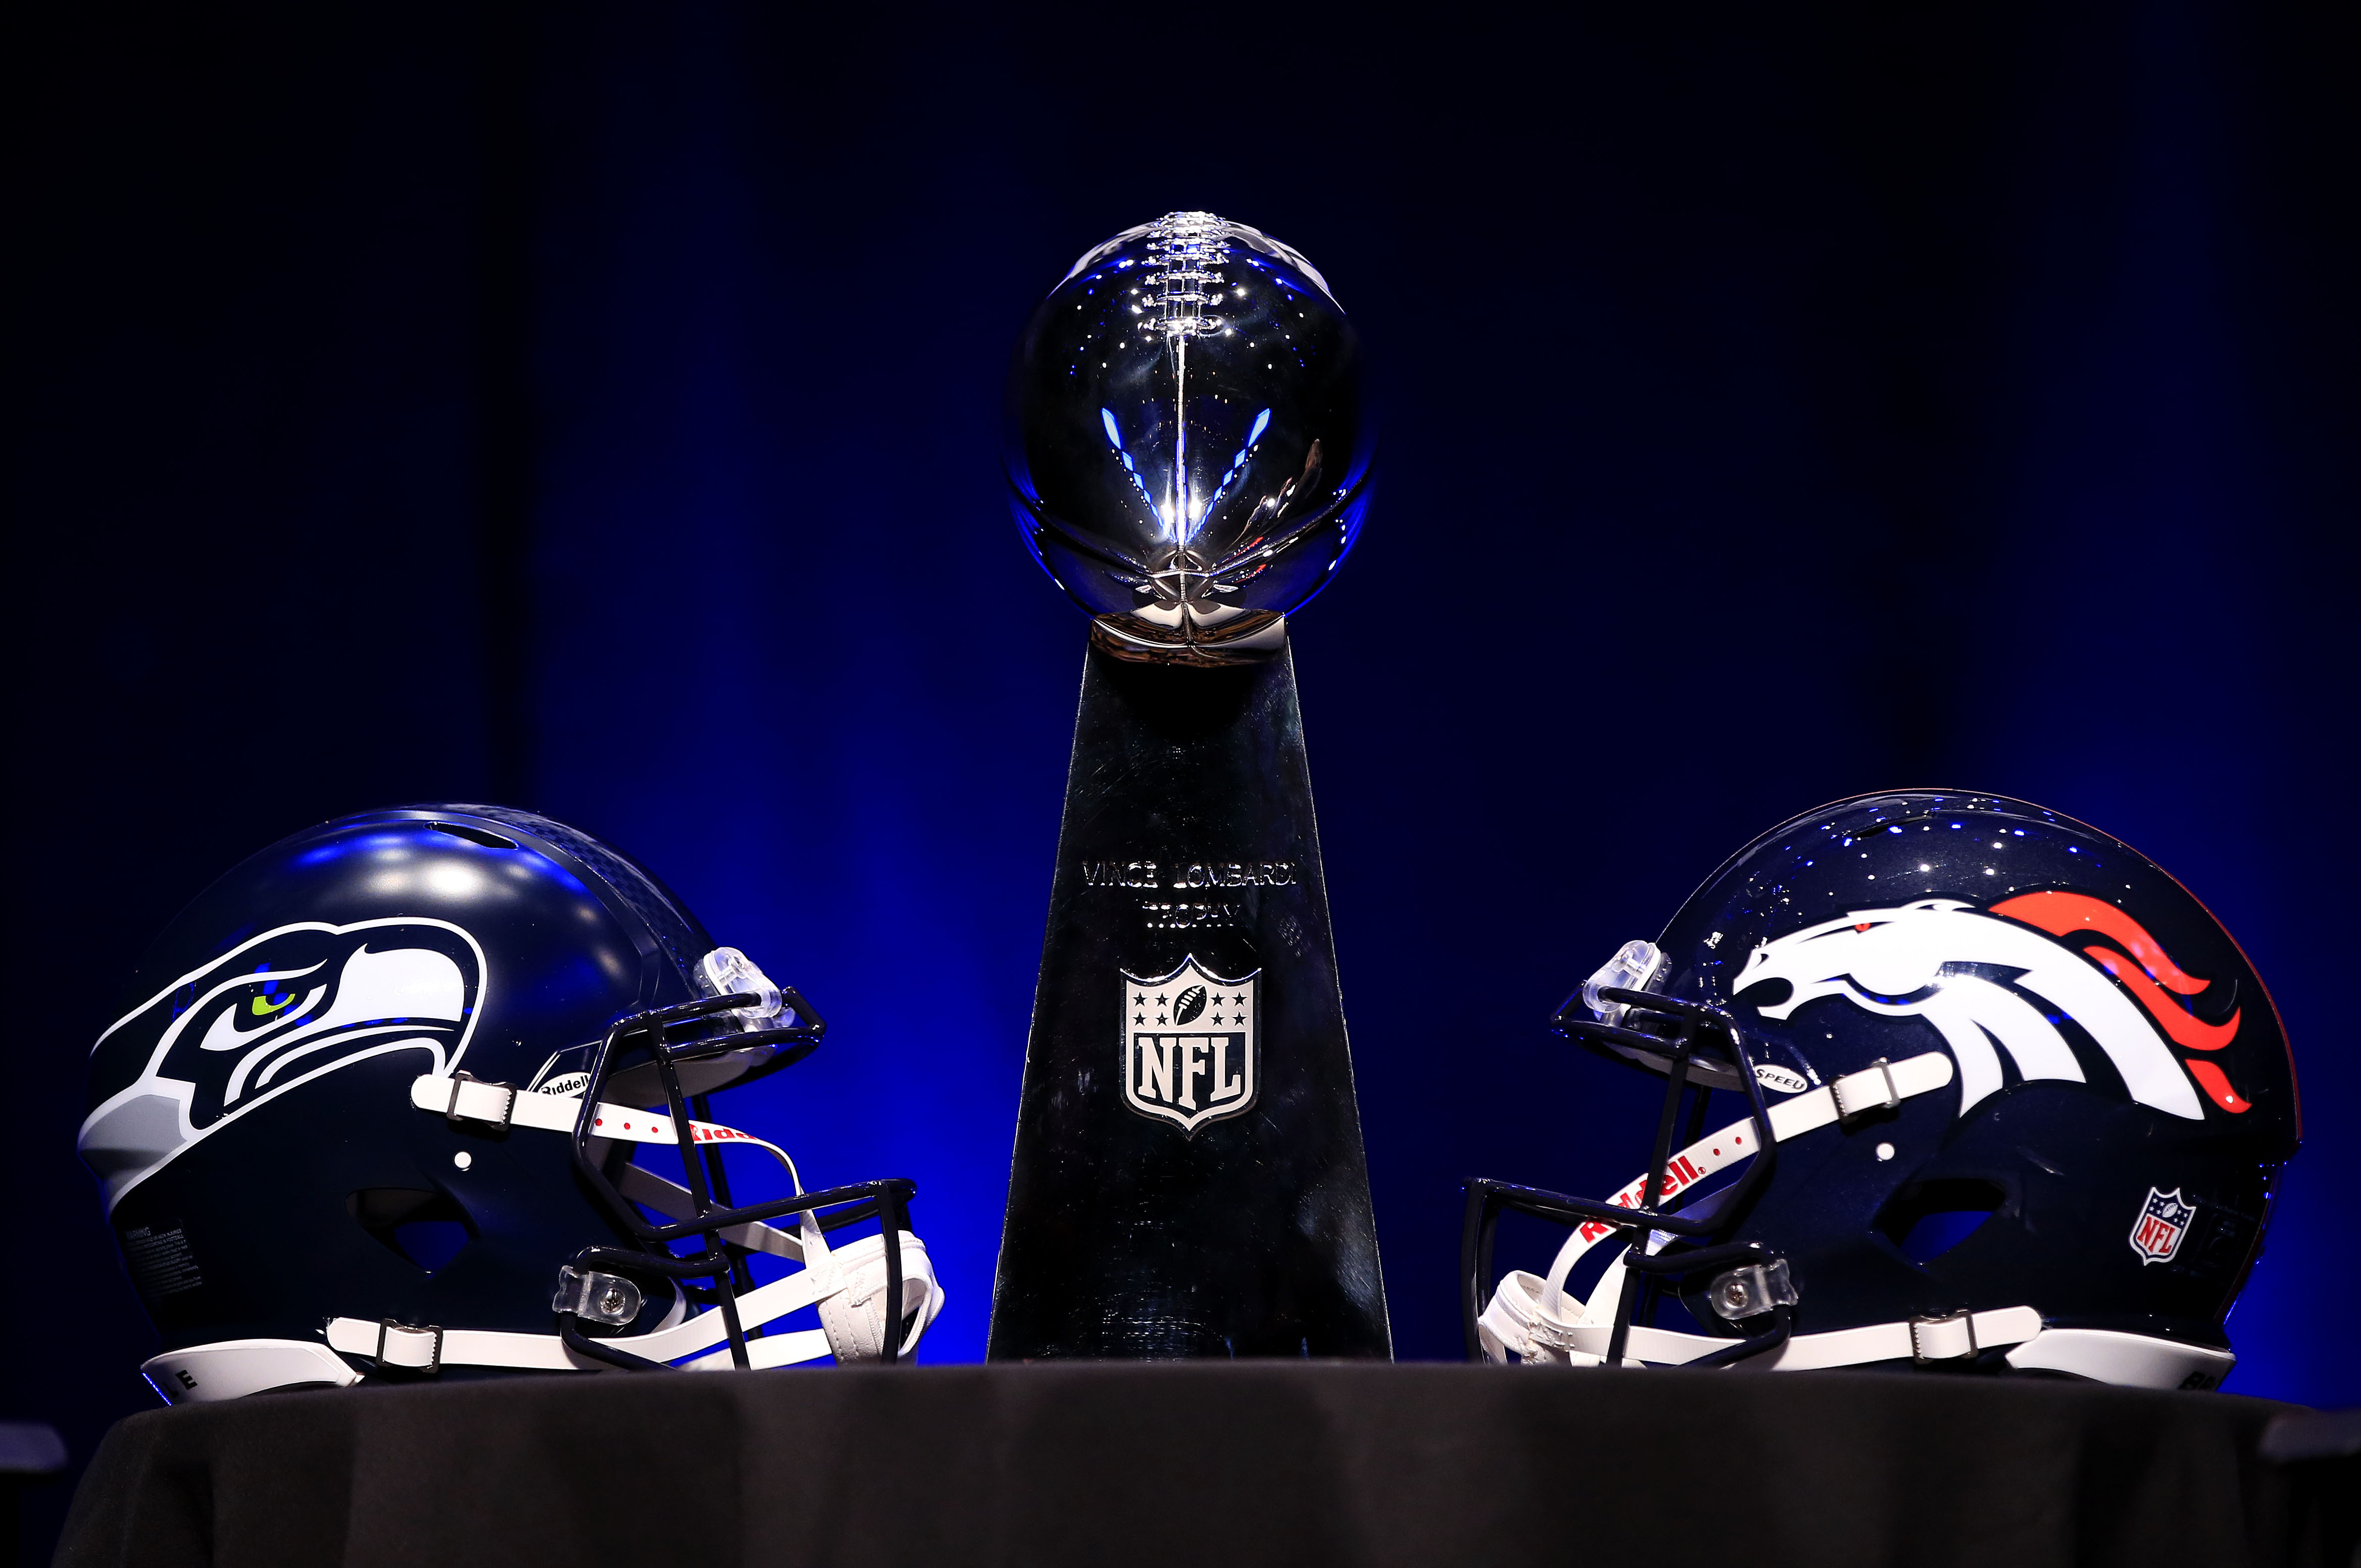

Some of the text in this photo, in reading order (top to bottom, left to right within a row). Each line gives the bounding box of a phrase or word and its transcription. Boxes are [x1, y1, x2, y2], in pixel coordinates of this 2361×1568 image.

[1083, 860, 1297, 888] VINCE LOMBARDI
[1142, 901, 1241, 928] TROPHY
[1138, 1037, 1241, 1110] NFL
[1755, 1069, 1805, 1090] SPEED
[2137, 1216, 2176, 1253] NFL
